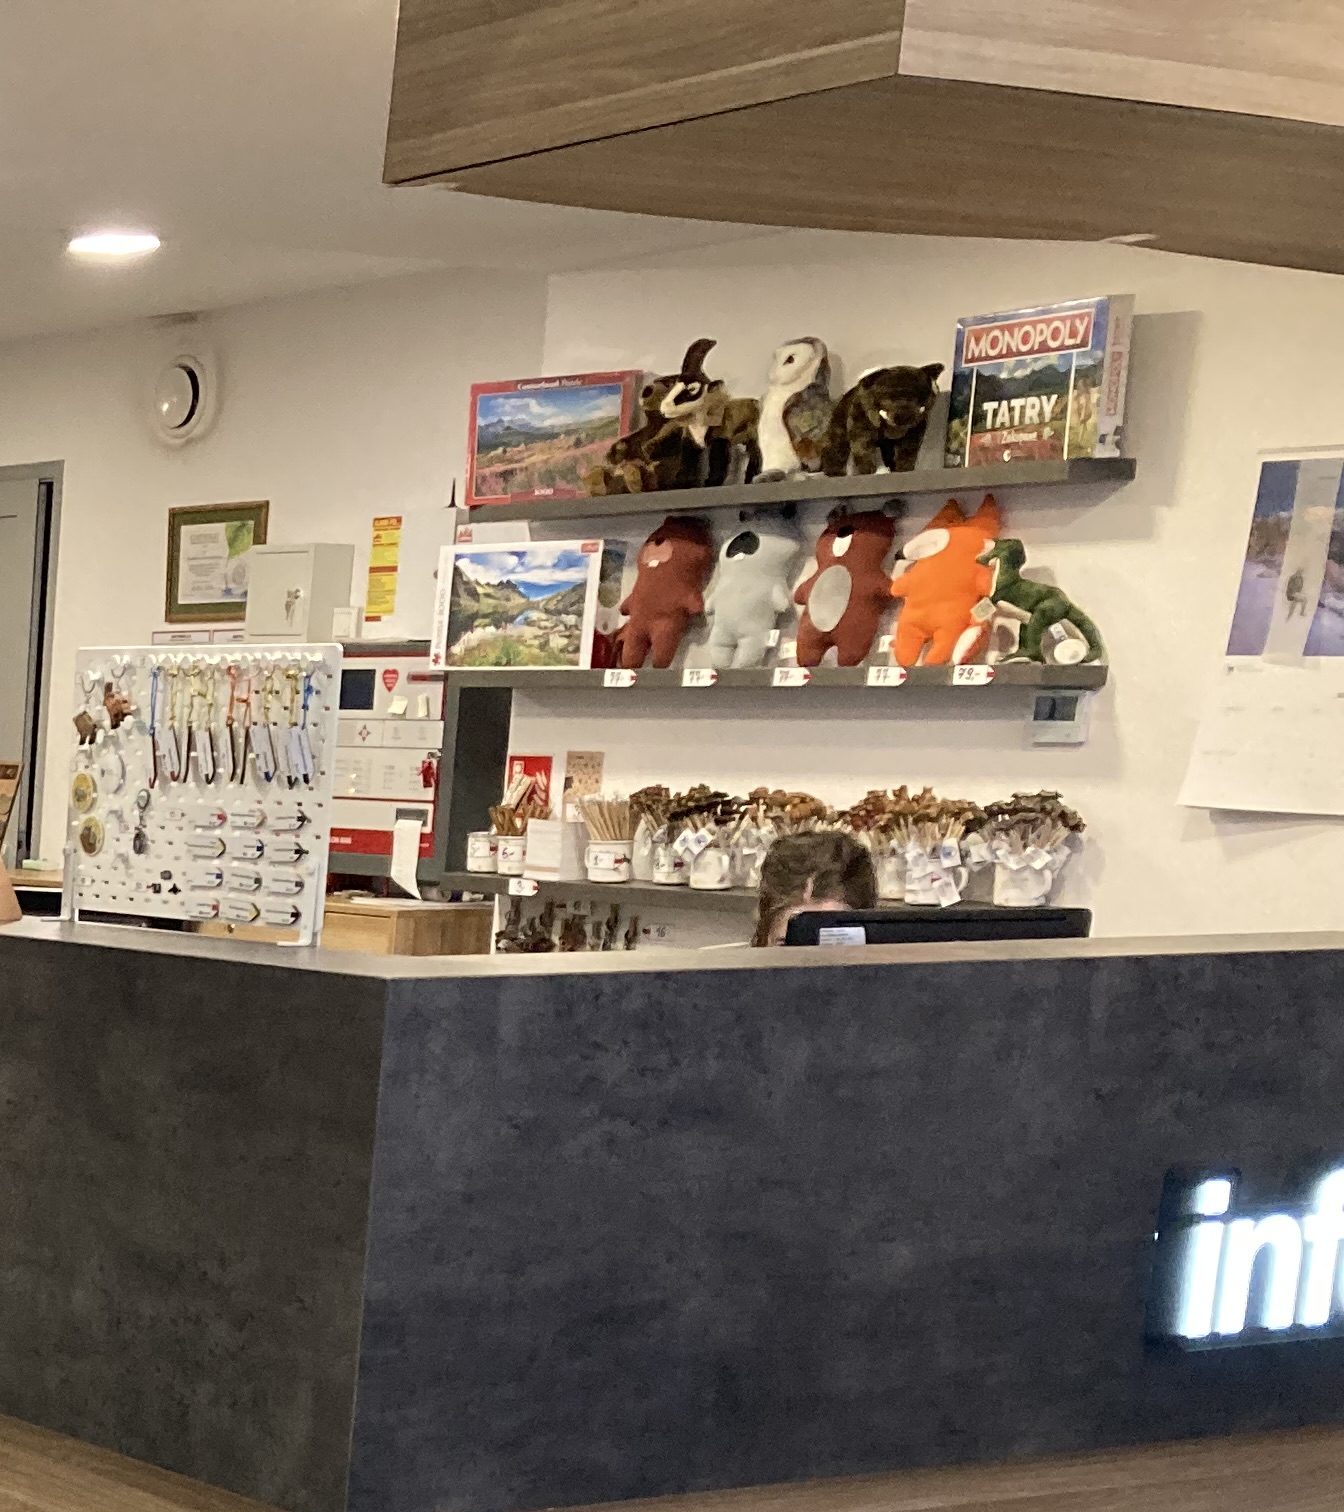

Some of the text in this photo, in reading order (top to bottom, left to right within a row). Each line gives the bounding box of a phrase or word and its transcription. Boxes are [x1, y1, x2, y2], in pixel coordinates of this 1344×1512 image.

[967, 316, 1089, 360] MONOPOLY
[983, 394, 1059, 429] TATRY
[1176, 1167, 1344, 1339] inf
